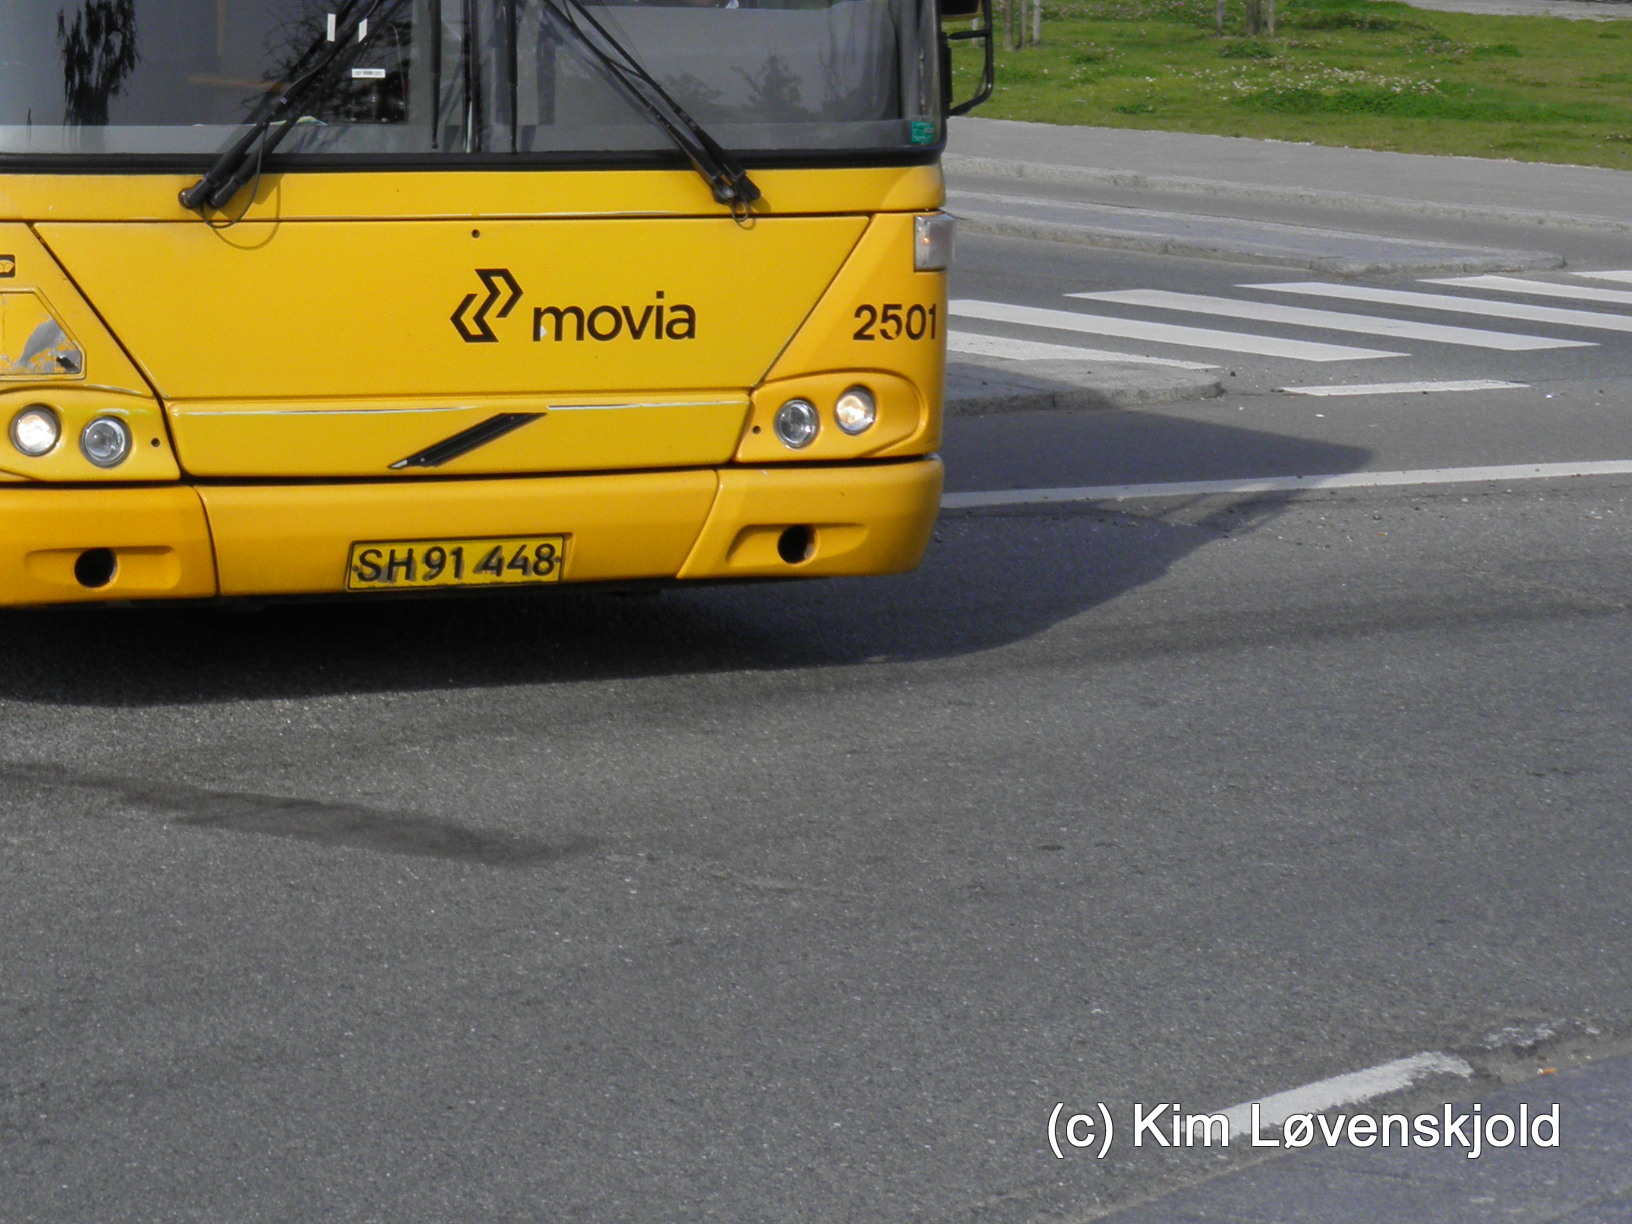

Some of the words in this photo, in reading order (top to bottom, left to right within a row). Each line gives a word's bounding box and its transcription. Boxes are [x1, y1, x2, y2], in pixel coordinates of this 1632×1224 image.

[532, 290, 697, 342] movia
[852, 303, 938, 341] 2501
[357, 548, 414, 582] SH
[423, 546, 464, 581] 91
[475, 543, 556, 578] 448
